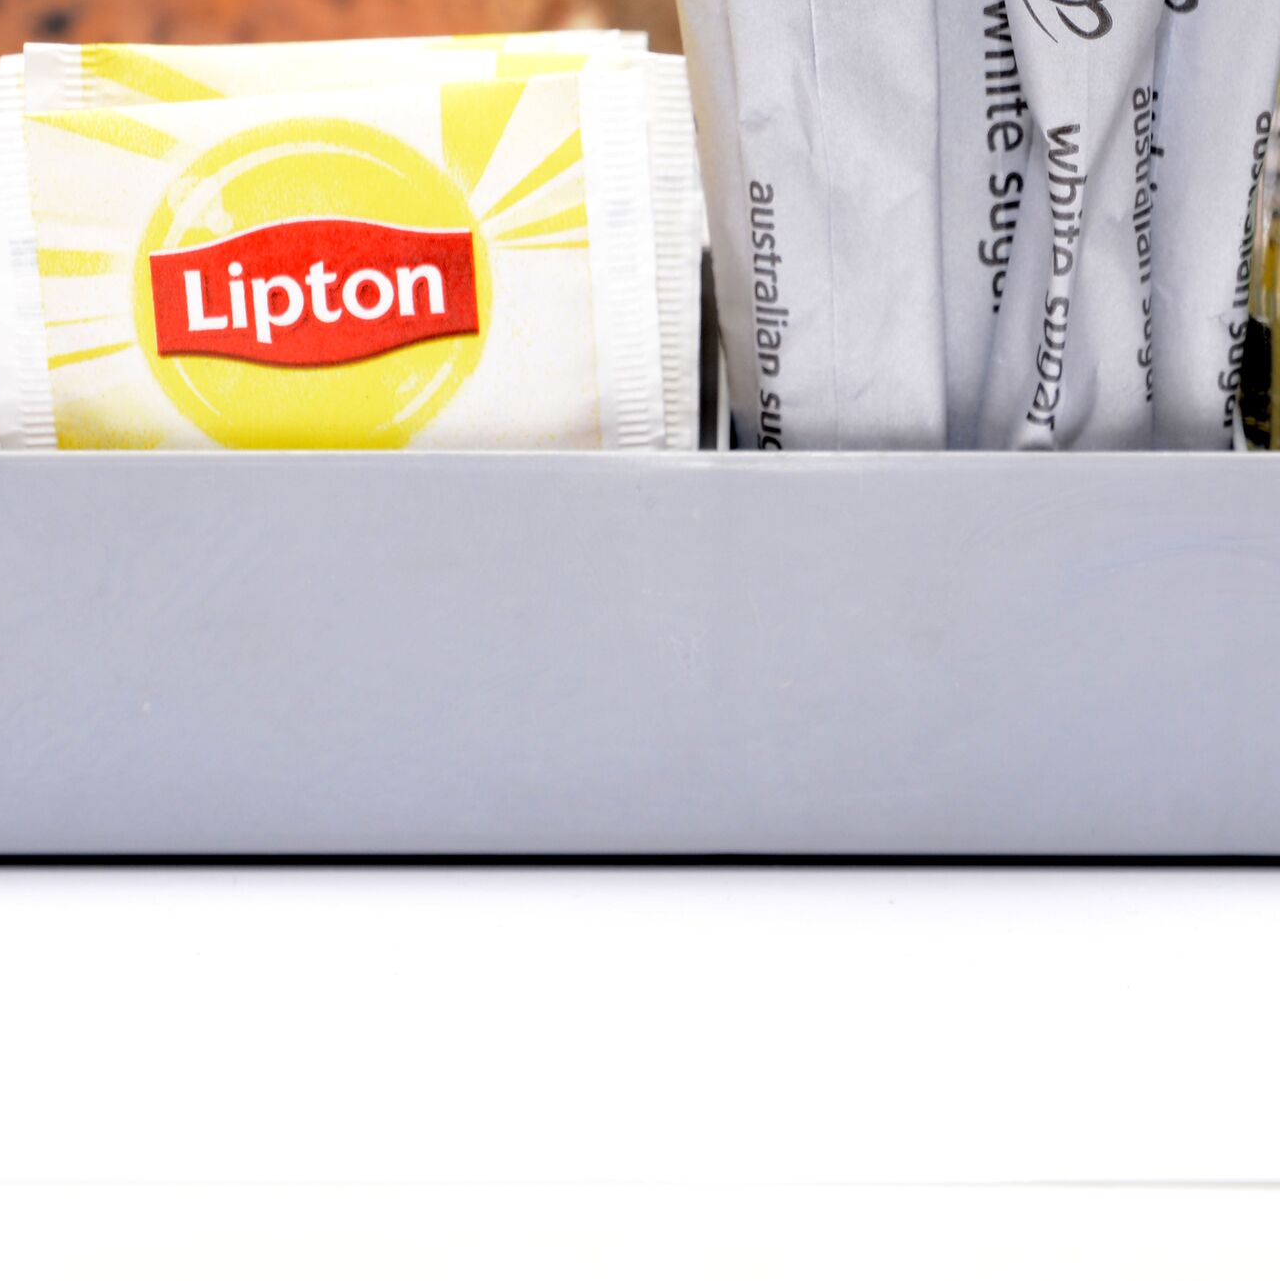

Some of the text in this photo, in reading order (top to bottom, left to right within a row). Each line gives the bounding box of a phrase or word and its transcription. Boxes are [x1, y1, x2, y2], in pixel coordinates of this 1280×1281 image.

[1047, 123, 1088, 277] white
[183, 261, 446, 344] Lipton
[749, 180, 790, 377] australian
